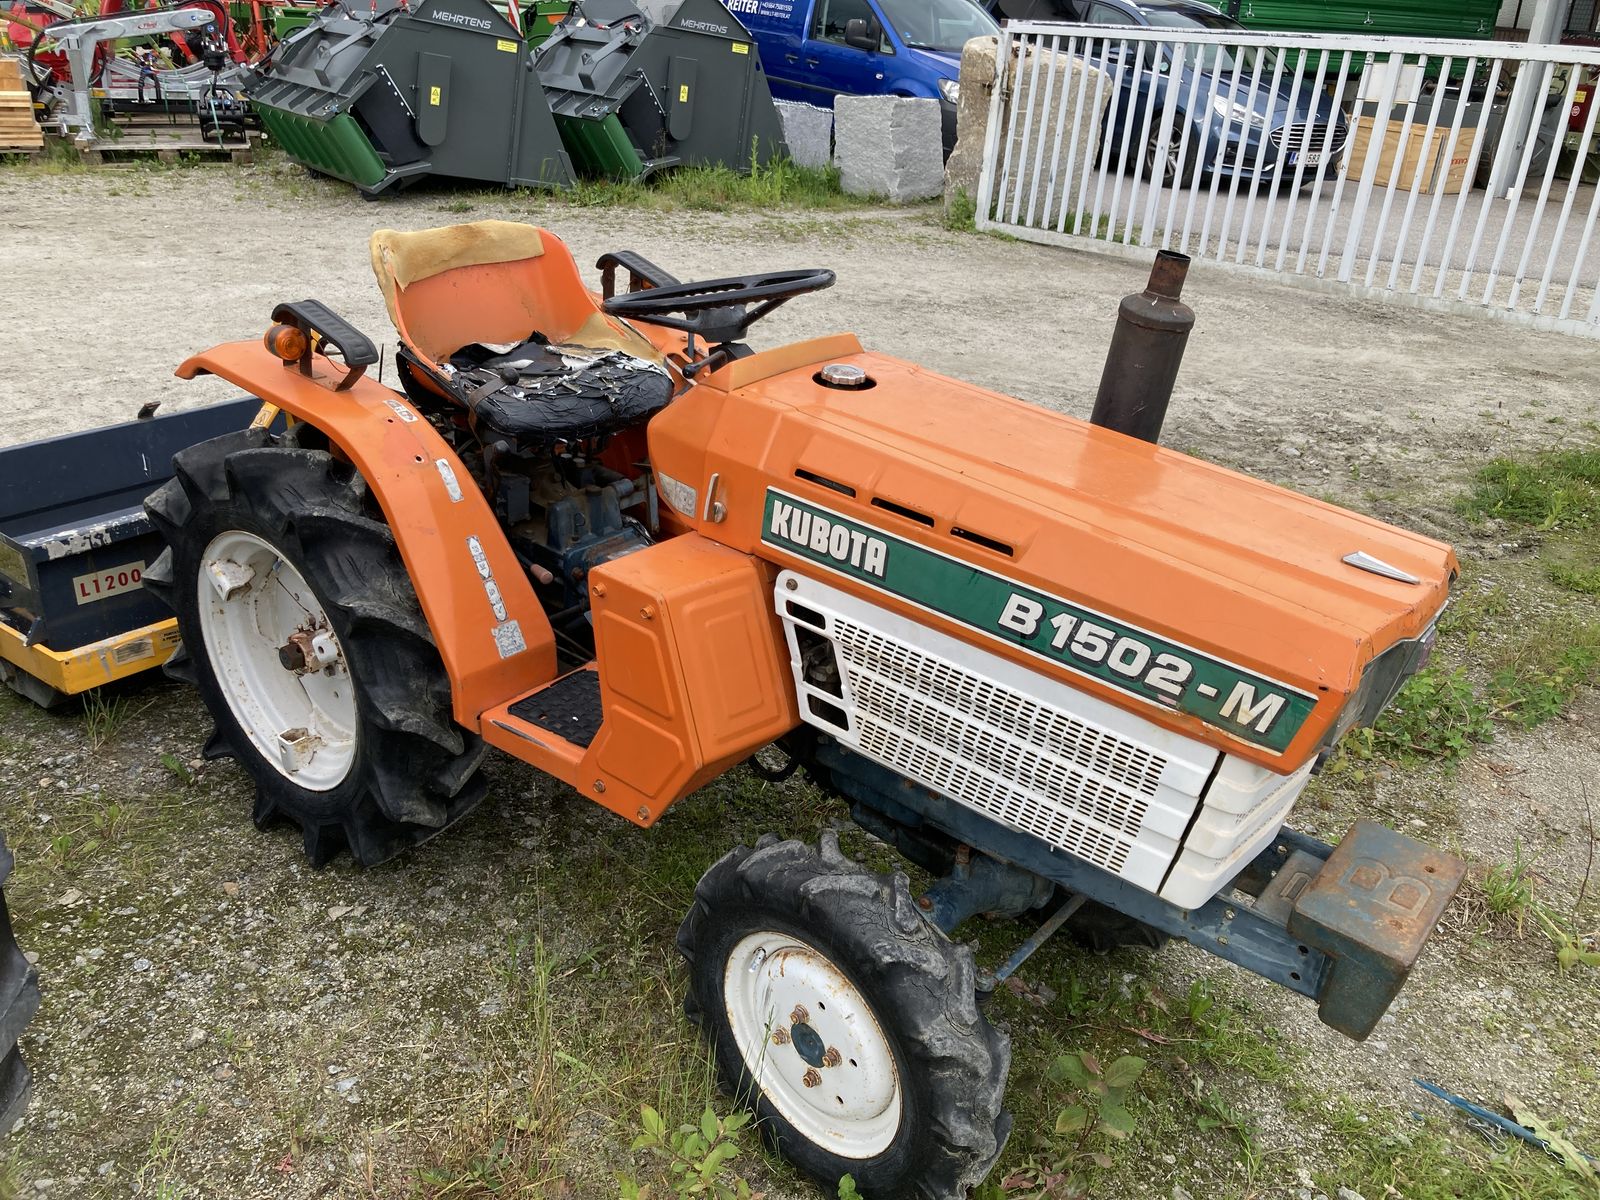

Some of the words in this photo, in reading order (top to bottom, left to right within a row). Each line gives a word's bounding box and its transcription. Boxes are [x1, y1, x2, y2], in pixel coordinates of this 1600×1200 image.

[727, 0, 759, 14] REITER
[432, 9, 492, 29] MEHRTENS
[680, 18, 728, 34] MEHRTENS
[770, 499, 888, 579] KUBOTA
[79, 568, 141, 598] L1200
